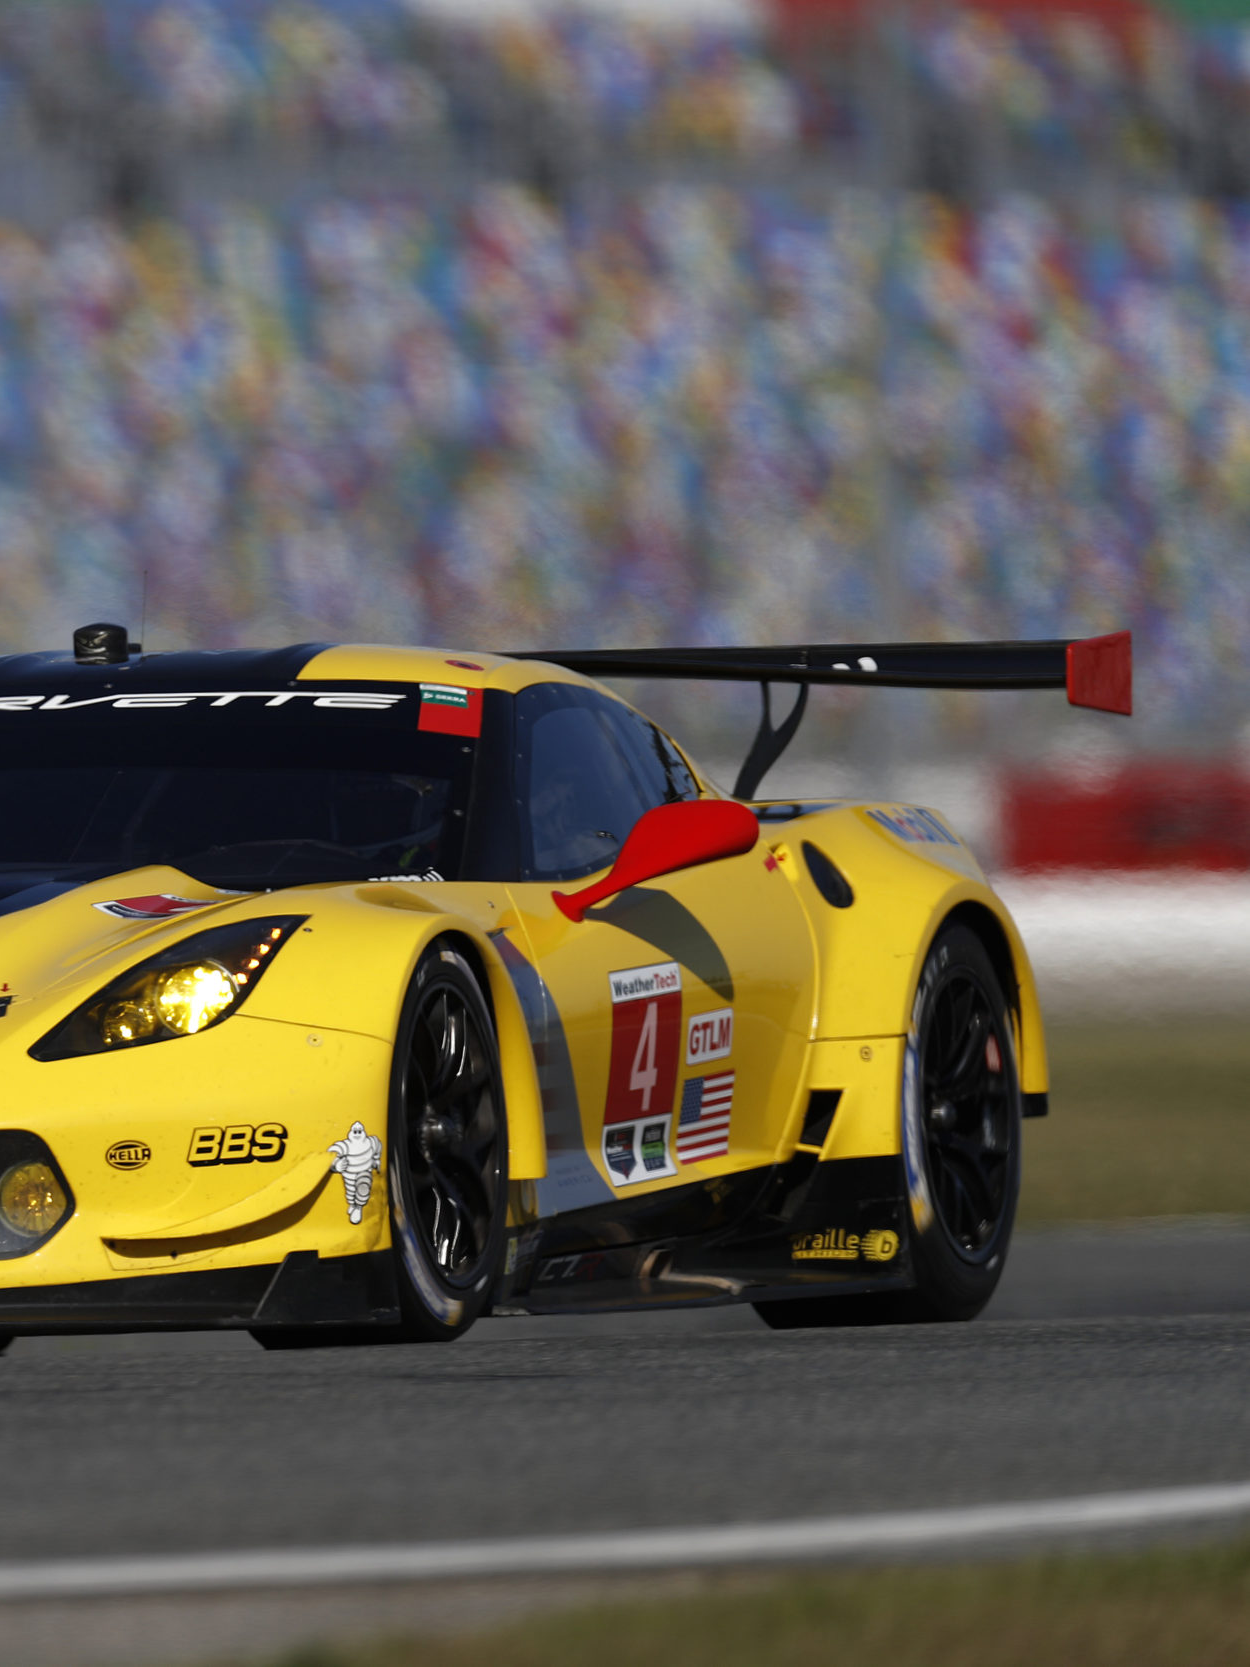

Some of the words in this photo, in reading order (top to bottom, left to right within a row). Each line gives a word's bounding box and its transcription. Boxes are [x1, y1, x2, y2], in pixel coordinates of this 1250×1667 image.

[612, 971, 678, 997] WeatherTech
[690, 1016, 732, 1056] GTLM
[630, 1001, 658, 1112] 4
[108, 1147, 151, 1161] HELLA
[186, 1122, 289, 1168] BBS
